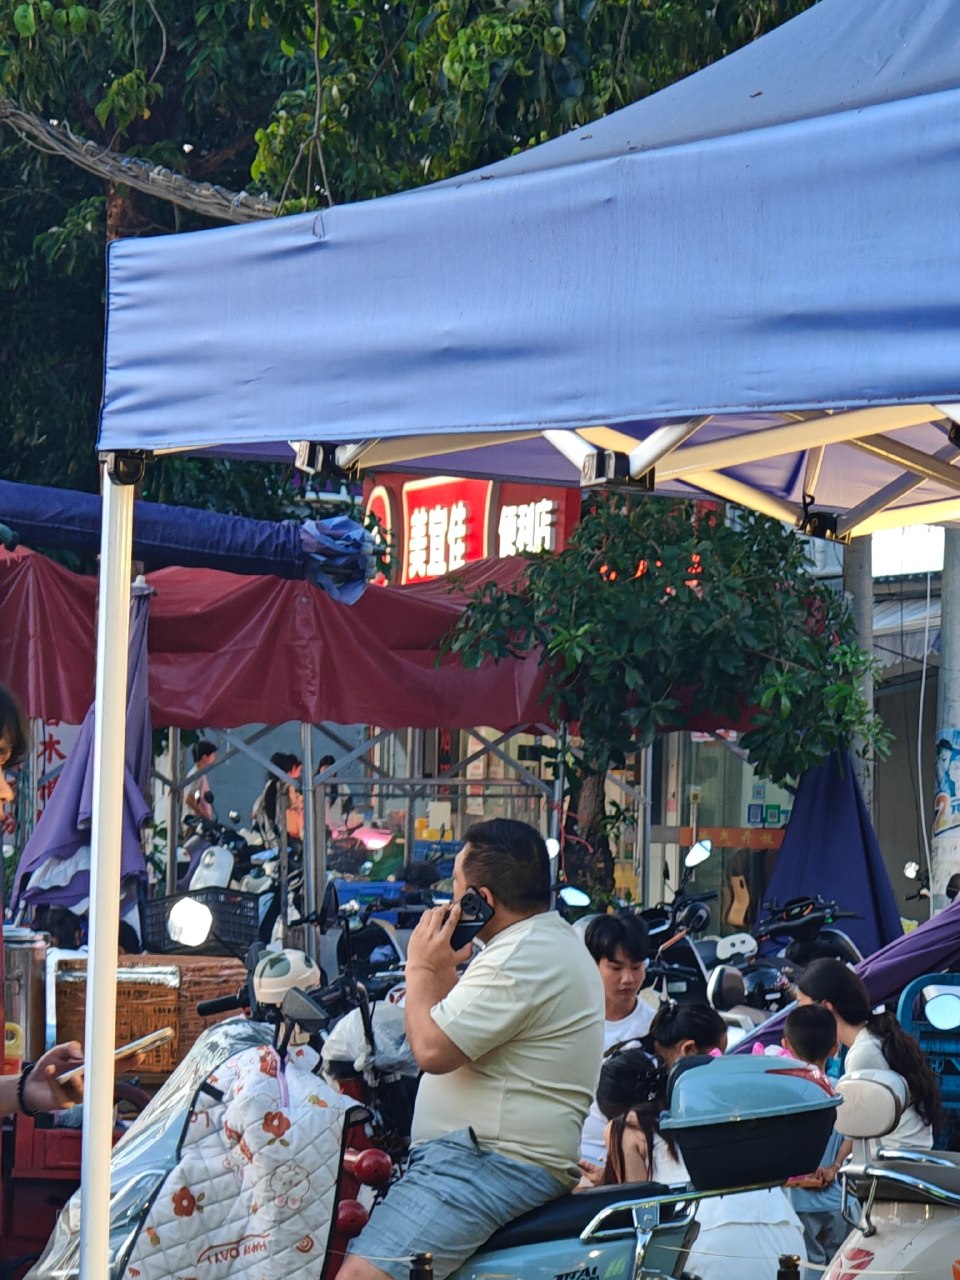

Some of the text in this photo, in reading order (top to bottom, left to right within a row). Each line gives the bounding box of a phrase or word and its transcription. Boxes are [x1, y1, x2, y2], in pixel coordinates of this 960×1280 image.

[409, 498, 553, 579] 美宜佳 便利店
